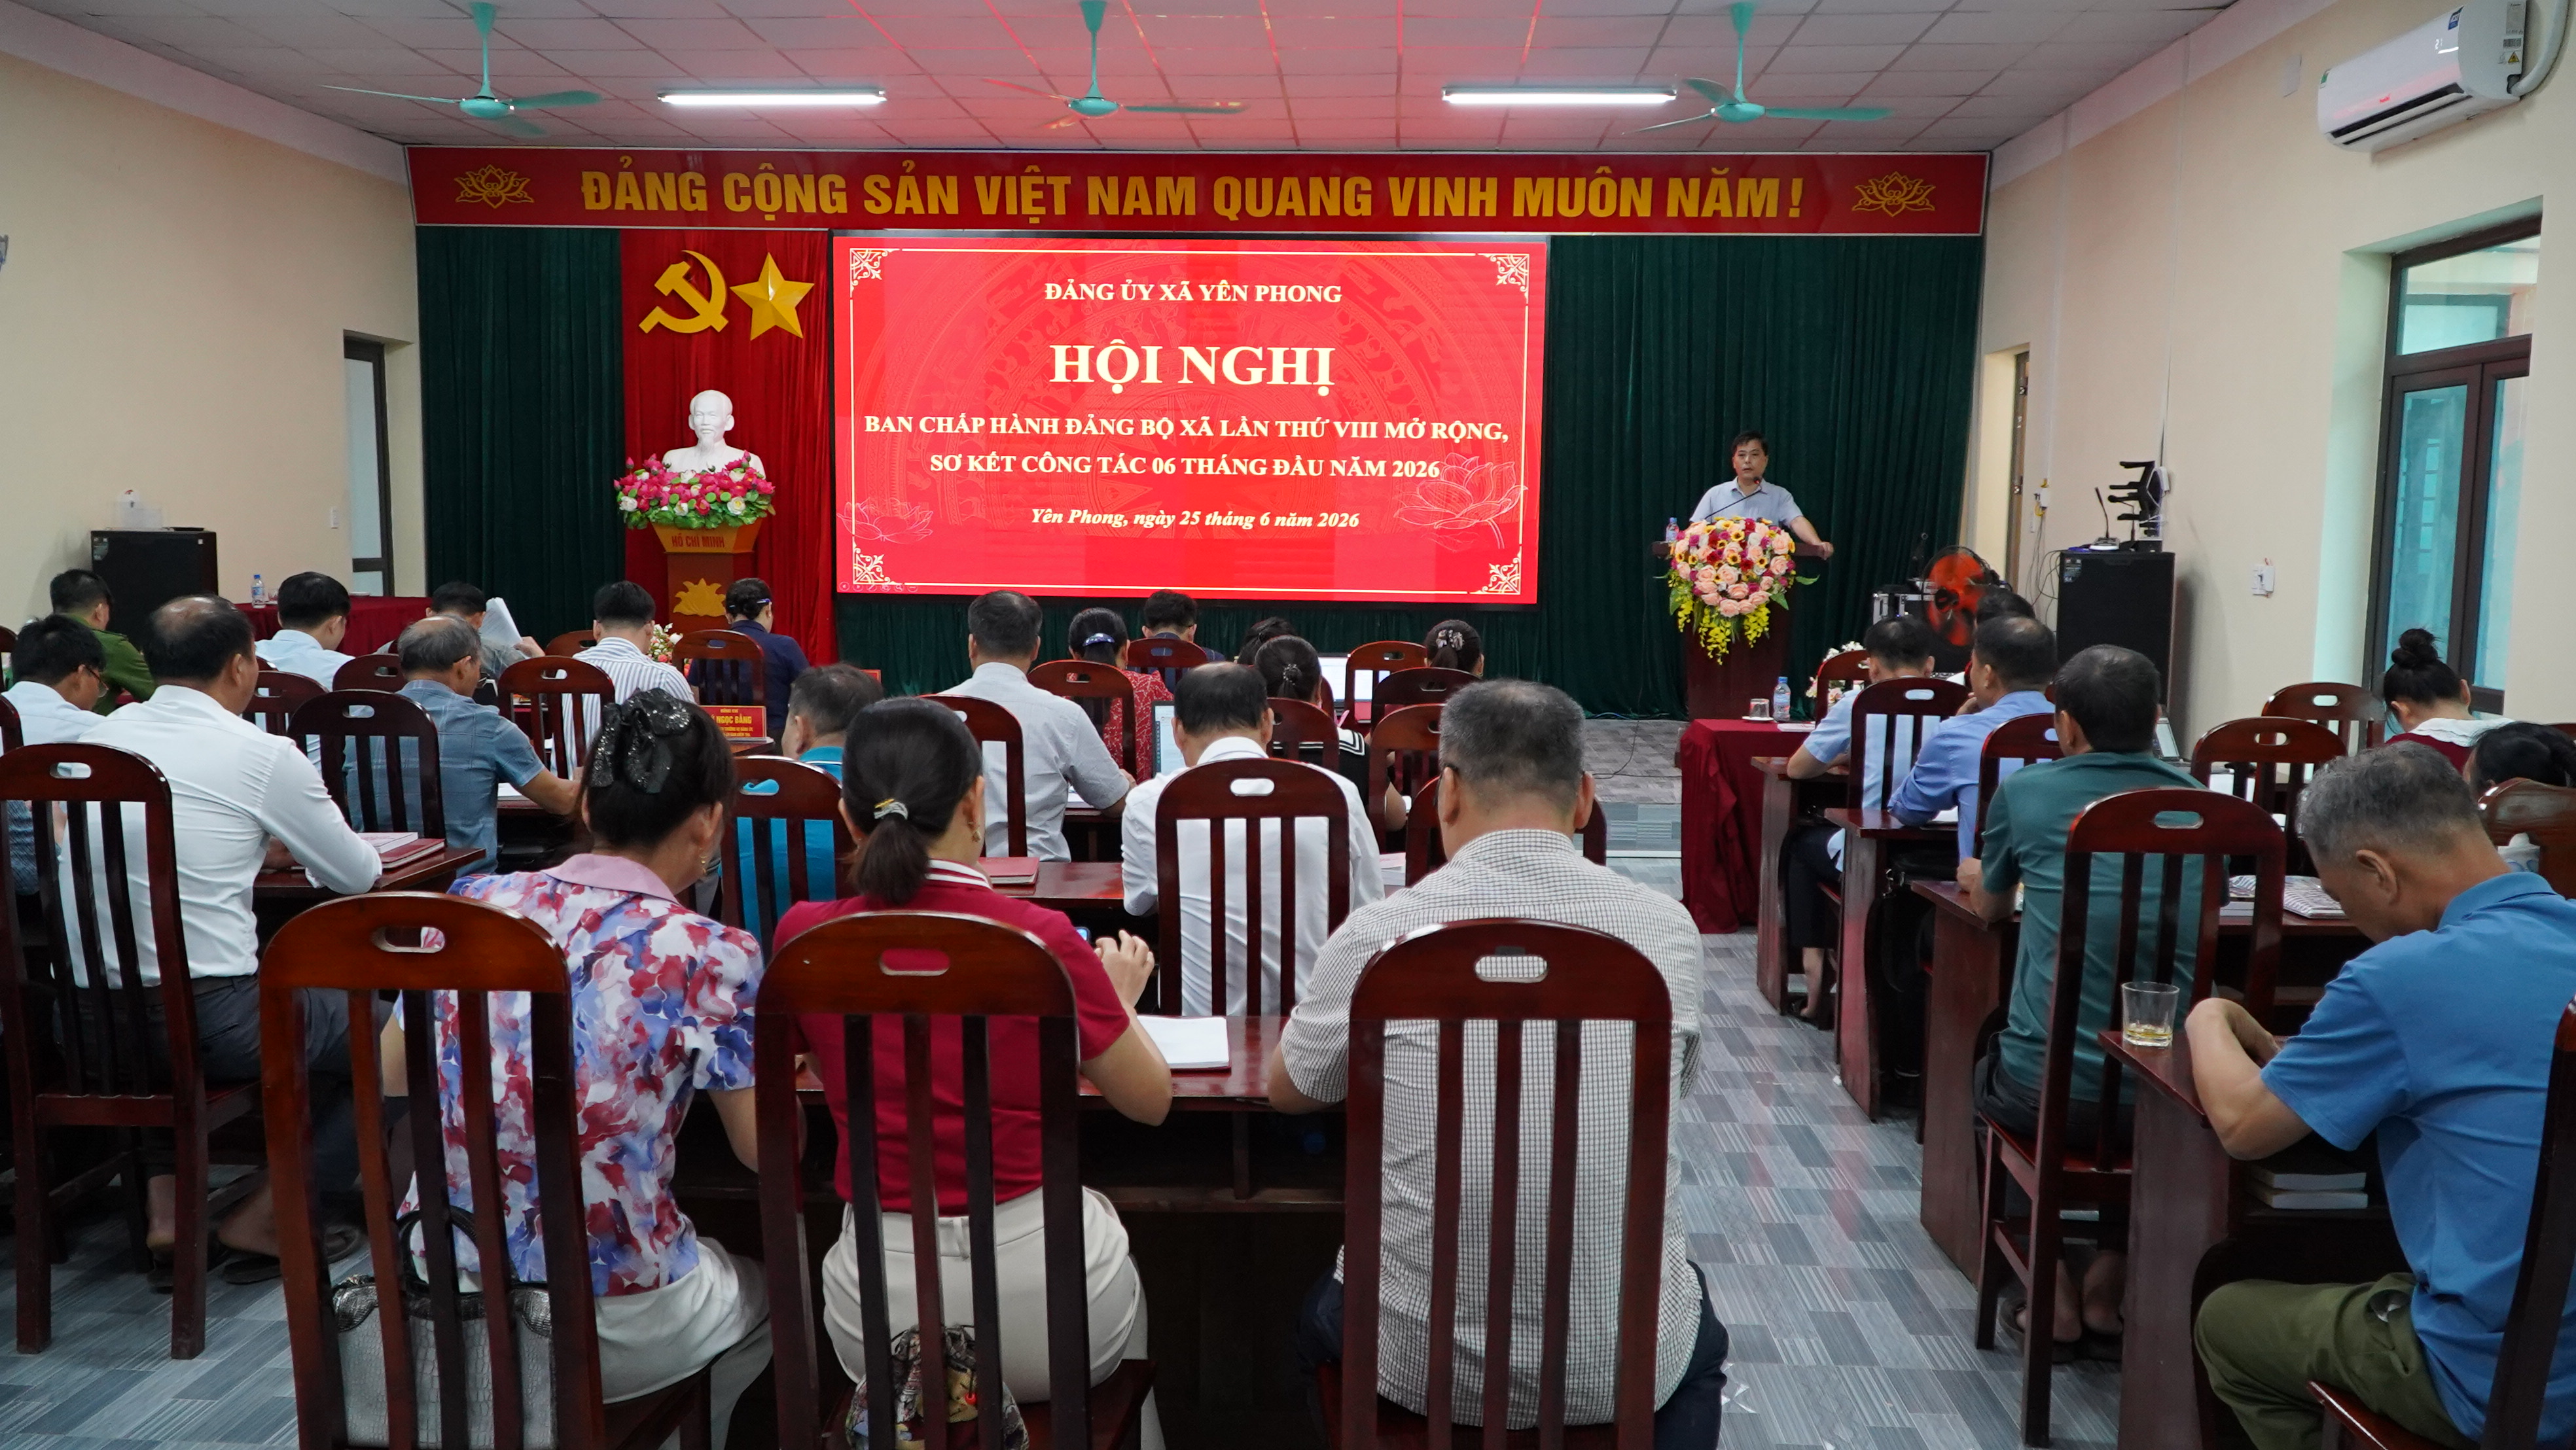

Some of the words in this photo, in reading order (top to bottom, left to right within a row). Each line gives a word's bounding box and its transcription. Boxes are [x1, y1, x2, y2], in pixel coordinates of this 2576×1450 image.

[581, 156, 708, 212] ĐẢNG
[723, 163, 848, 221] CỘNG
[864, 160, 959, 215] SẢN
[975, 165, 1071, 224] VIỆT
[1088, 177, 1196, 216] NAM
[1214, 177, 1372, 222] QUANG
[1388, 177, 1499, 217] VINH
[1513, 166, 1653, 218] MUÔN
[1045, 279, 1115, 301] ĐẢNG
[1120, 279, 1155, 301] ỦY
[1159, 280, 1194, 301] XÃ
[1198, 279, 1249, 302] YÊN
[1255, 285, 1343, 303] PHONG
[1049, 338, 1164, 395] HỘI
[1177, 346, 1336, 397] NGHỊ
[864, 416, 914, 433] BAN
[919, 412, 986, 434] CHẤP
[990, 413, 1060, 434] HÀNH
[1065, 414, 1135, 436] ĐẢNG
[1139, 417, 1174, 440] BỘ
[1179, 416, 1214, 436] XÃ
[1219, 416, 1270, 437] LẦN
[1274, 416, 1330, 438] THỨ
[1332, 421, 1379, 438] VIII
[1384, 417, 1427, 439] MỞ
[1430, 420, 1509, 444] RỘNG,
[930, 453, 963, 472] SƠ
[967, 451, 1017, 472] KẾT
[1021, 451, 1092, 473] CÔNG
[1096, 452, 1146, 474] TÁC
[1152, 457, 1176, 474] 06
[1181, 453, 1268, 476] THÁNG
[1272, 454, 1325, 476] ĐẦU
[1329, 455, 1387, 477] NĂM
[1391, 459, 1441, 478] 2026
[1031, 508, 1064, 524] Yên
[1067, 509, 1129, 528] Phong,
[1133, 510, 1176, 529] ngày
[1179, 510, 1202, 526] 25
[1204, 510, 1256, 530] tháng
[1259, 512, 1272, 527] 6
[1274, 512, 1314, 527] năm
[1316, 512, 1361, 527] 2026
